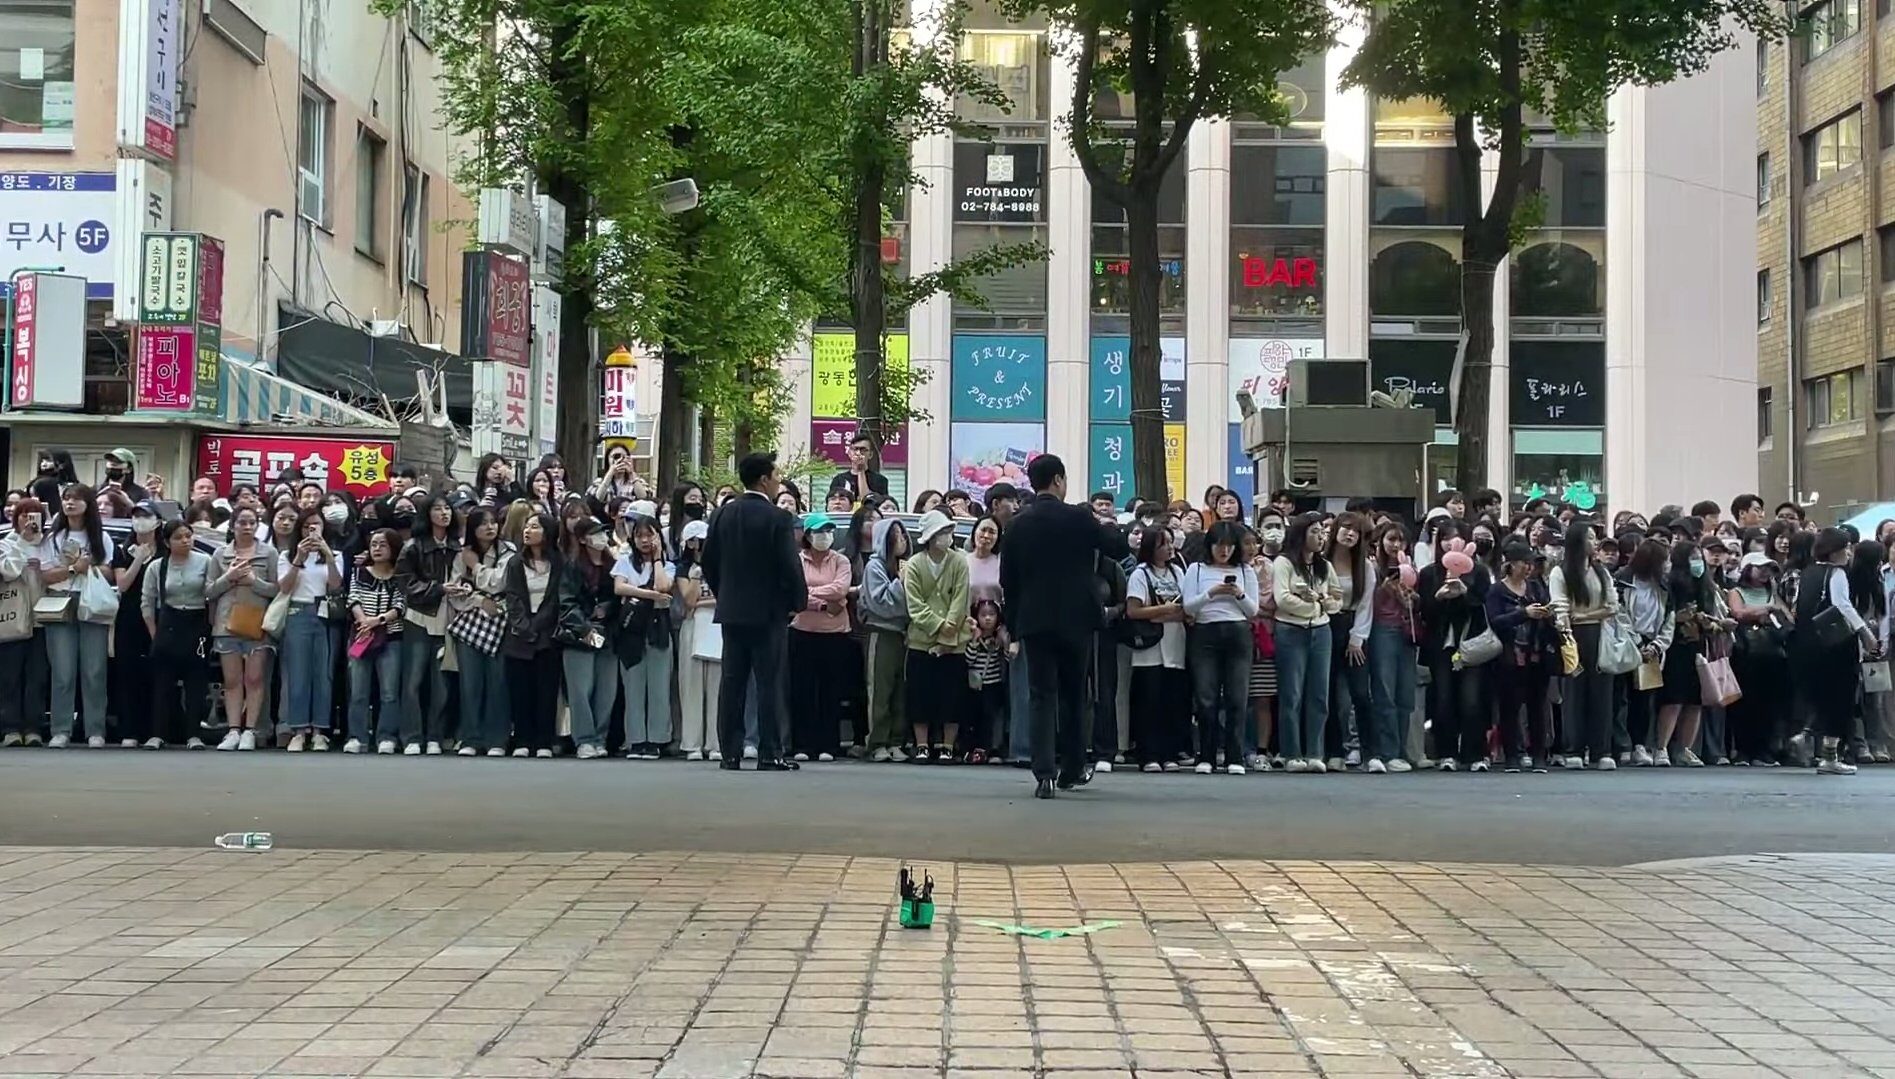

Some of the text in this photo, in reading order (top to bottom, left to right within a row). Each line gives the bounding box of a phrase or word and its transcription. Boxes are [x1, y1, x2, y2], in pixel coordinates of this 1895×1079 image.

[1, 175, 77, 190] 양도 기장
[6, 222, 107, 251] 무사 5F
[1243, 257, 1317, 287] BAR
[19, 278, 33, 292] YES
[971, 346, 1030, 367] FRUIT
[1299, 347, 1312, 358] 1F
[16, 327, 31, 401] 복싱
[155, 335, 181, 405] 피아노
[994, 369, 1005, 384] &
[179, 394, 190, 404] B1
[967, 381, 1032, 410] PRESENT
[1546, 405, 1566, 419] 1F
[350, 451, 379, 464] 유성
[351, 466, 377, 481] 5층
